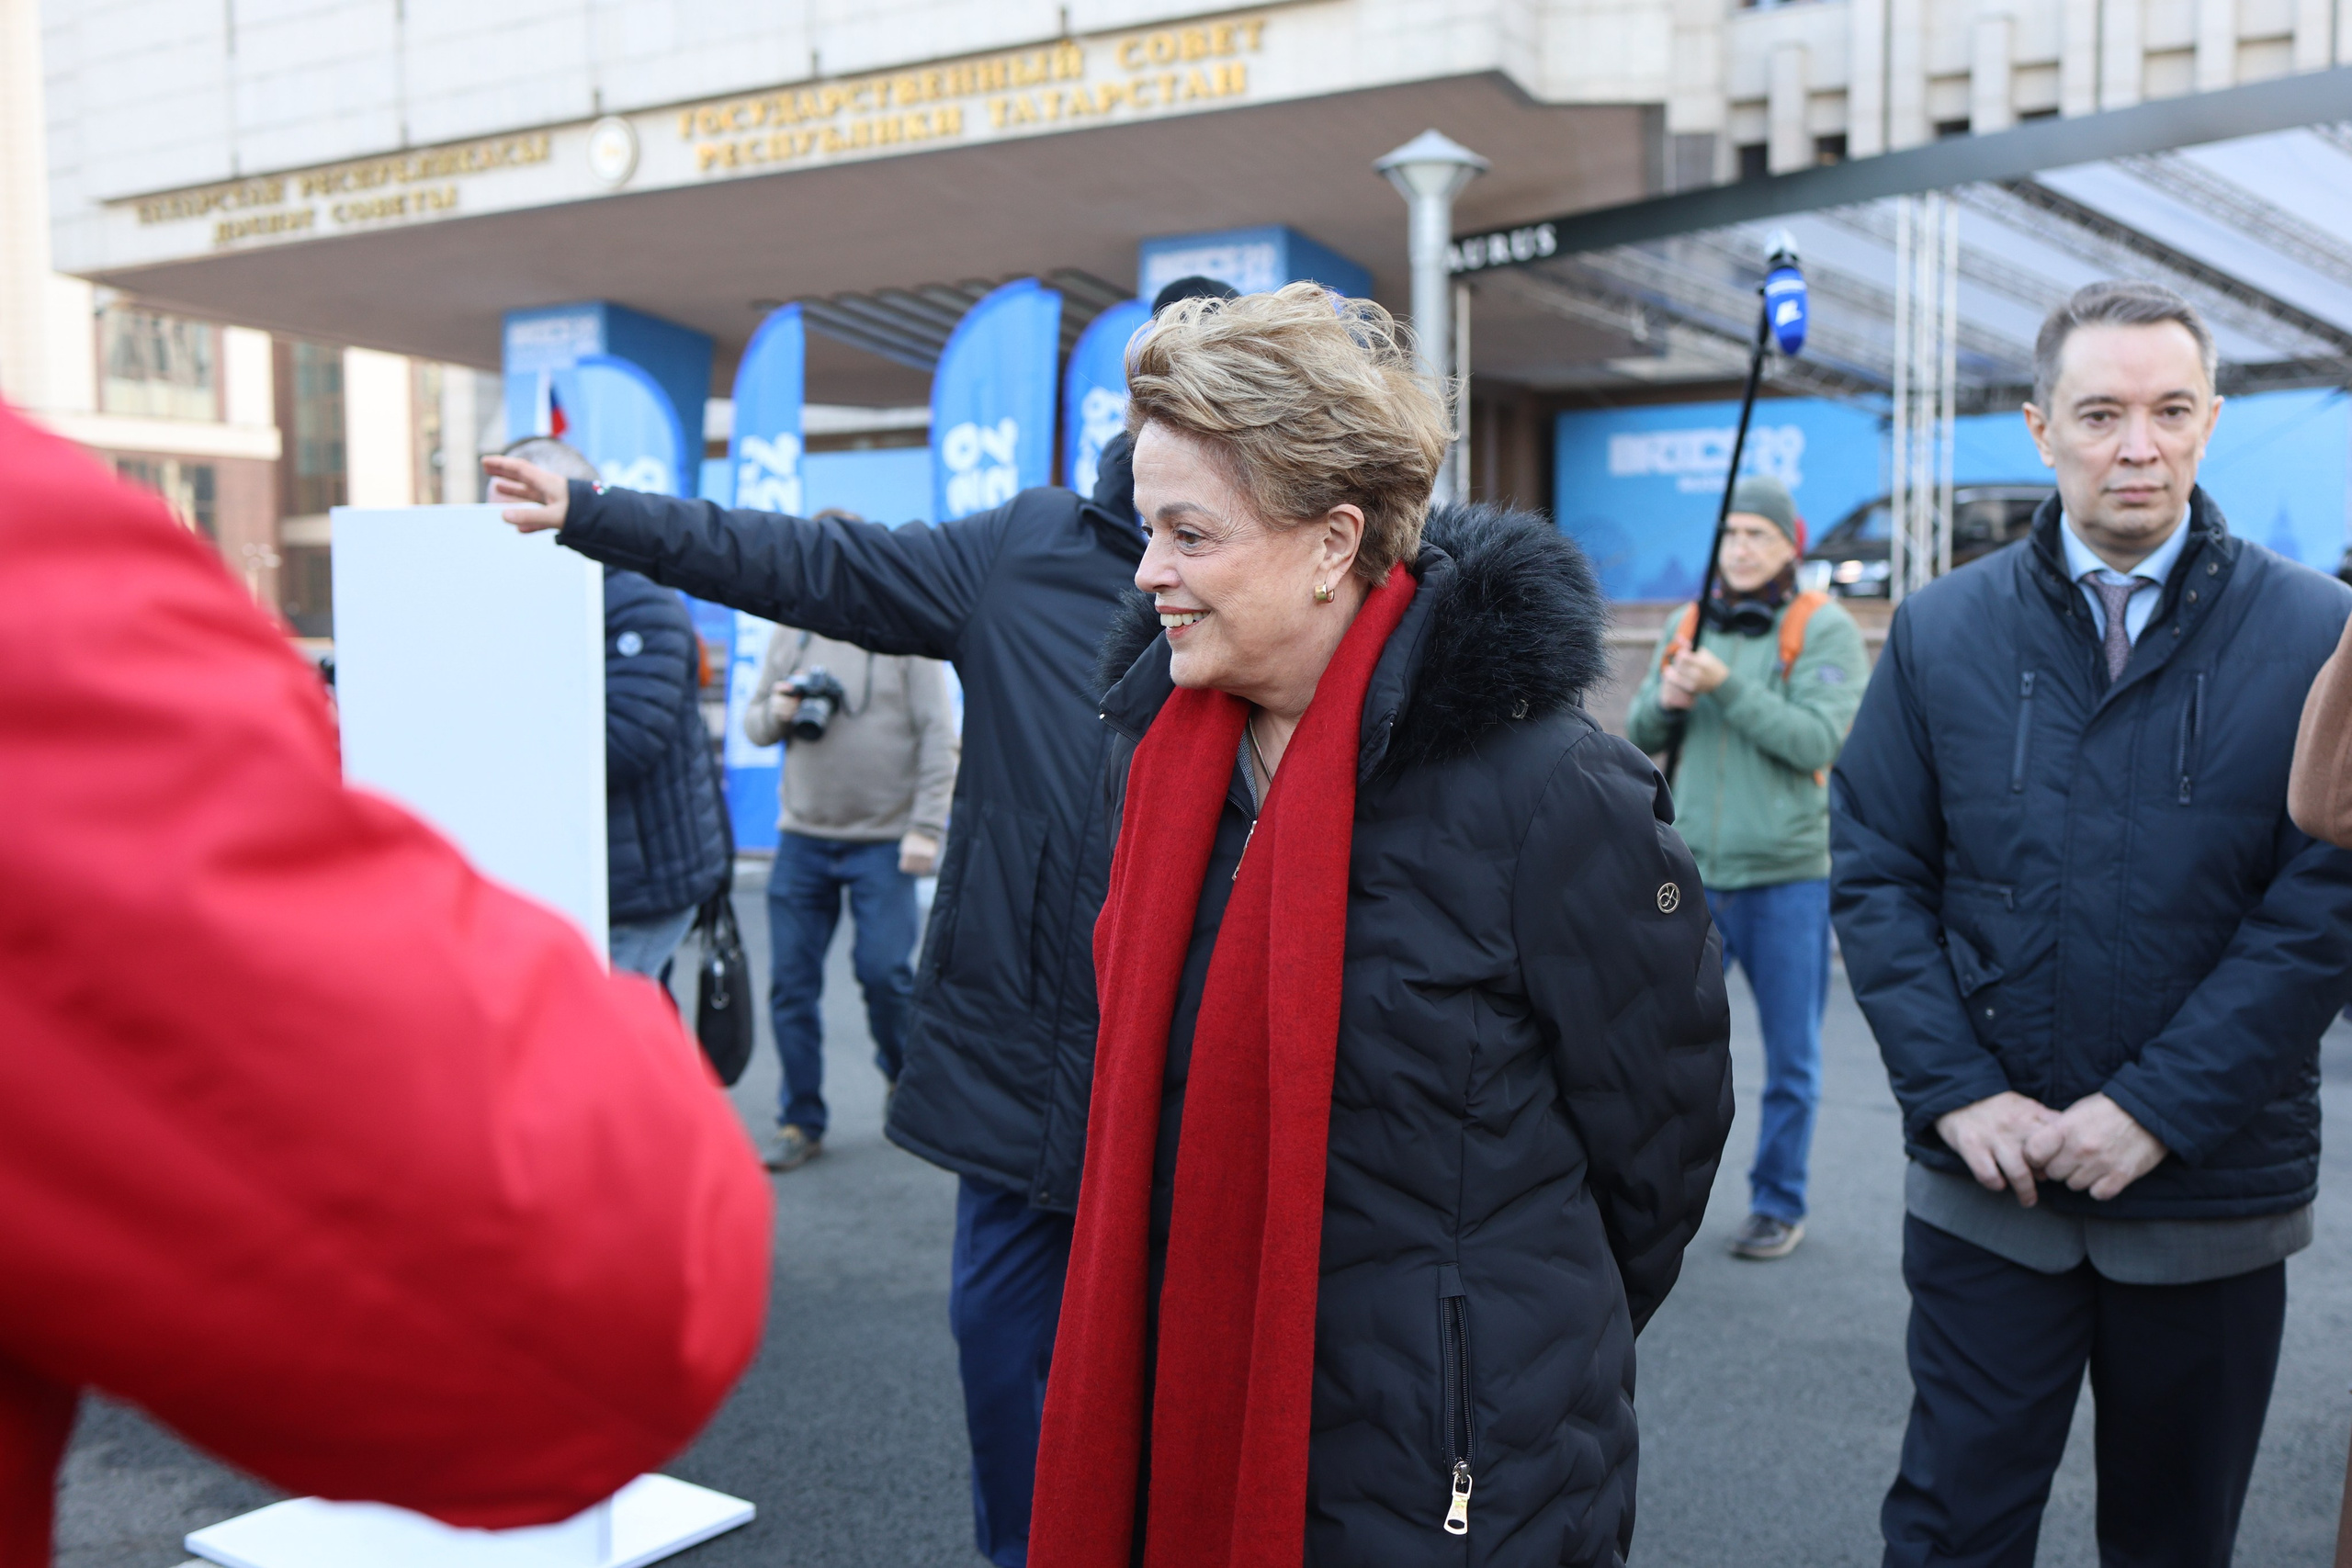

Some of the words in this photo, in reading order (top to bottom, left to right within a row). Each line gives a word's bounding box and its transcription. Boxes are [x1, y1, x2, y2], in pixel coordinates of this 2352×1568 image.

[677, 39, 1084, 140] ГОСУДАРСТВЕННЫЙ
[1116, 18, 1266, 71] СОВЕТ
[695, 107, 963, 172] РЕСПУБЛИКИ
[986, 62, 1247, 128] ТАТАРСТАН
